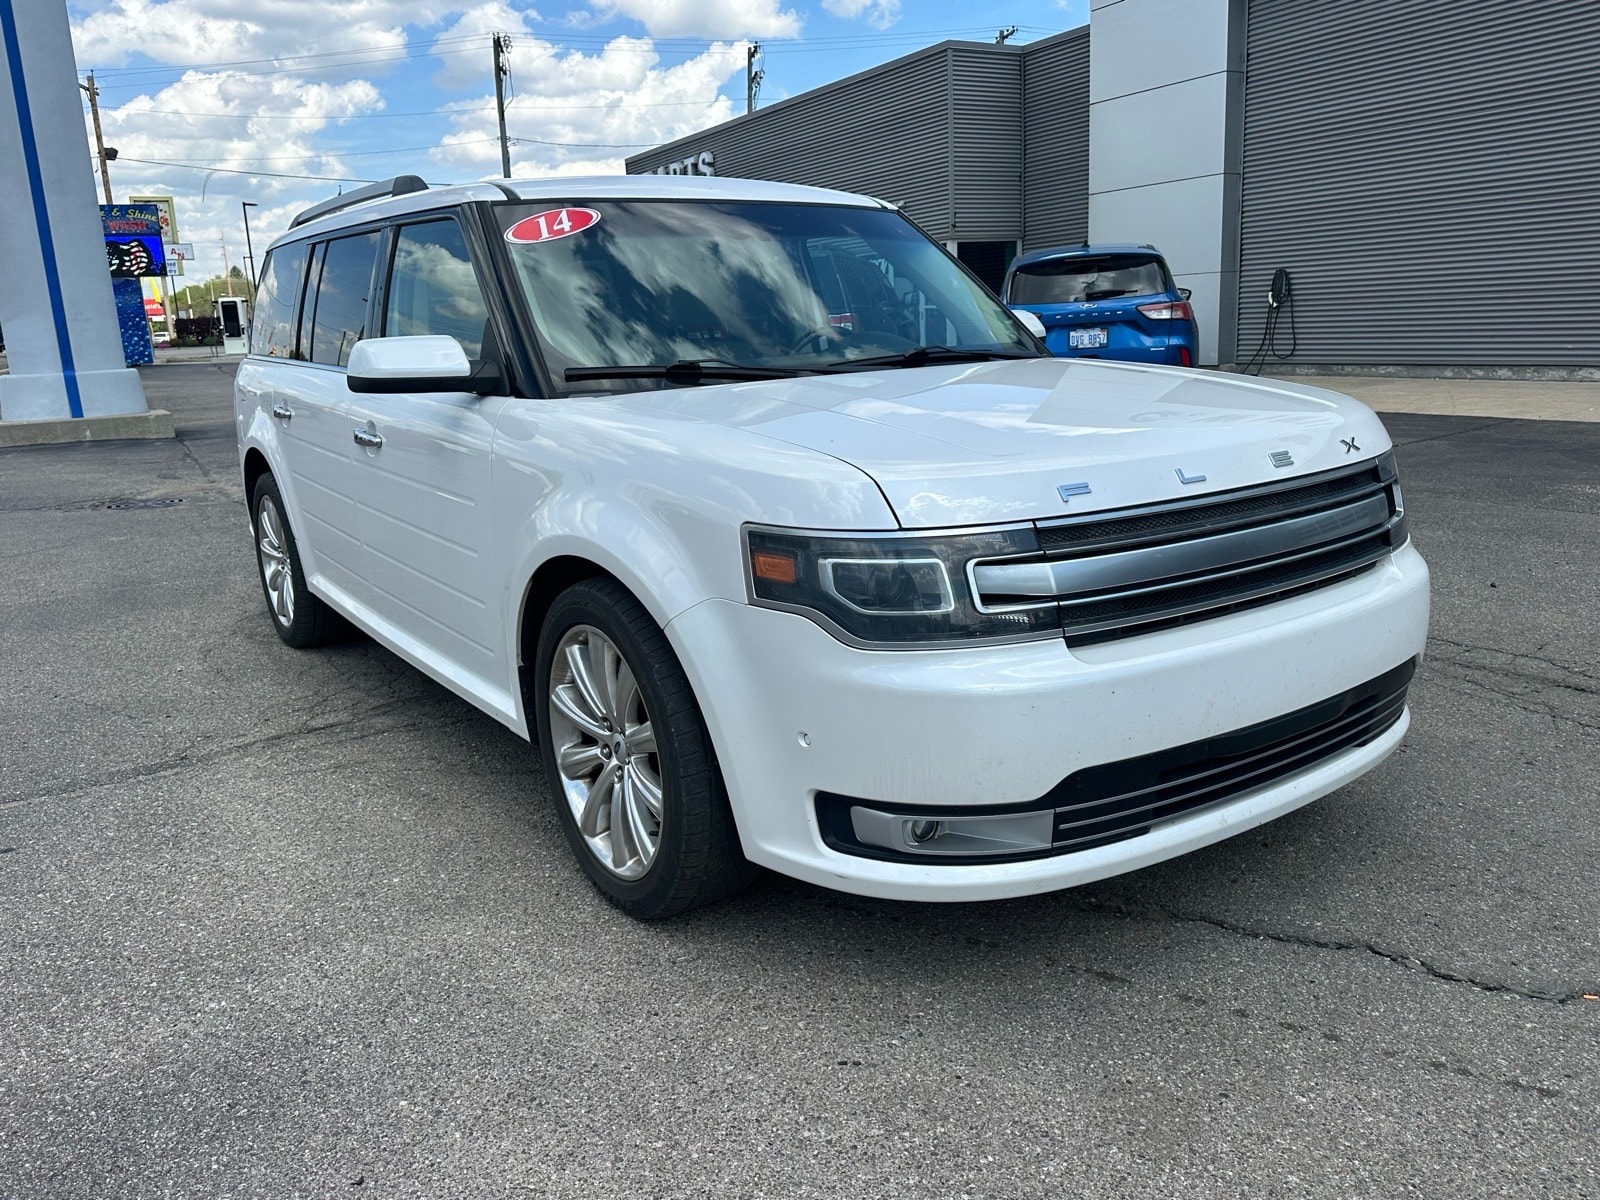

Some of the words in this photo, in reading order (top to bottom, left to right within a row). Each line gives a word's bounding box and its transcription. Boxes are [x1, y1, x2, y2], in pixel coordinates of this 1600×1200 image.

[108, 219, 147, 231] WASH
[126, 208, 158, 222] Shine
[533, 209, 573, 240] 14
[1057, 436, 1361, 503] FLEX
